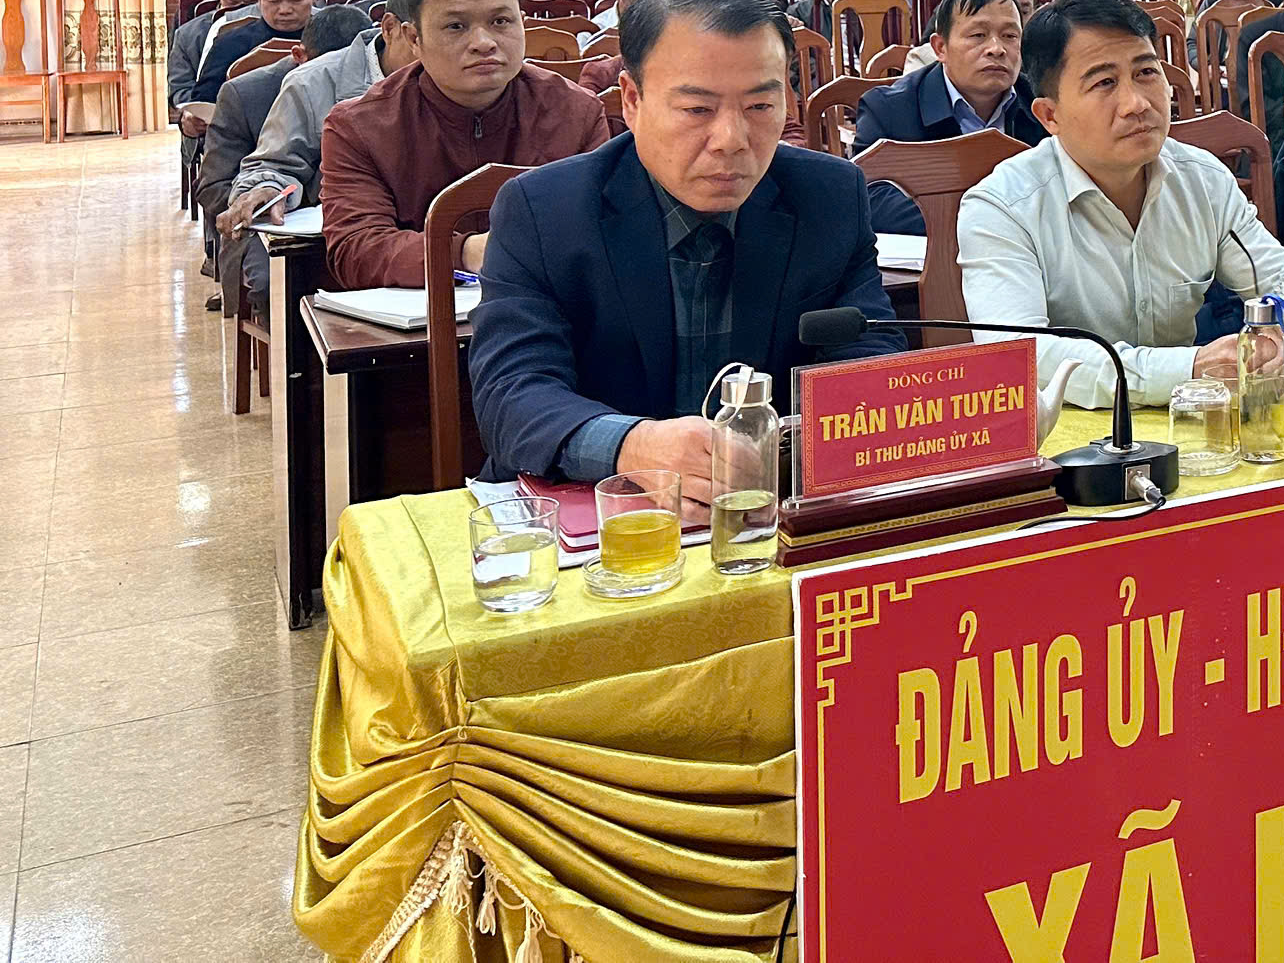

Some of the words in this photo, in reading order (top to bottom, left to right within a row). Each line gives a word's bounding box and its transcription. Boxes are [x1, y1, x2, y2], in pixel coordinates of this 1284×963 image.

[937, 363, 965, 382] CHÍ
[819, 402, 887, 441] TRẦN
[894, 396, 943, 429] VĂN
[950, 383, 1024, 420] TUYÊN
[855, 447, 871, 467] BÍ
[875, 443, 904, 463] THƯ
[906, 436, 946, 458] ĐẢNG
[950, 430, 968, 450] ỦY
[971, 427, 991, 447] XÃ
[896, 613, 1085, 804] ĐẢNG
[1107, 576, 1184, 748] ỦY
[984, 799, 1195, 963] XÃ
